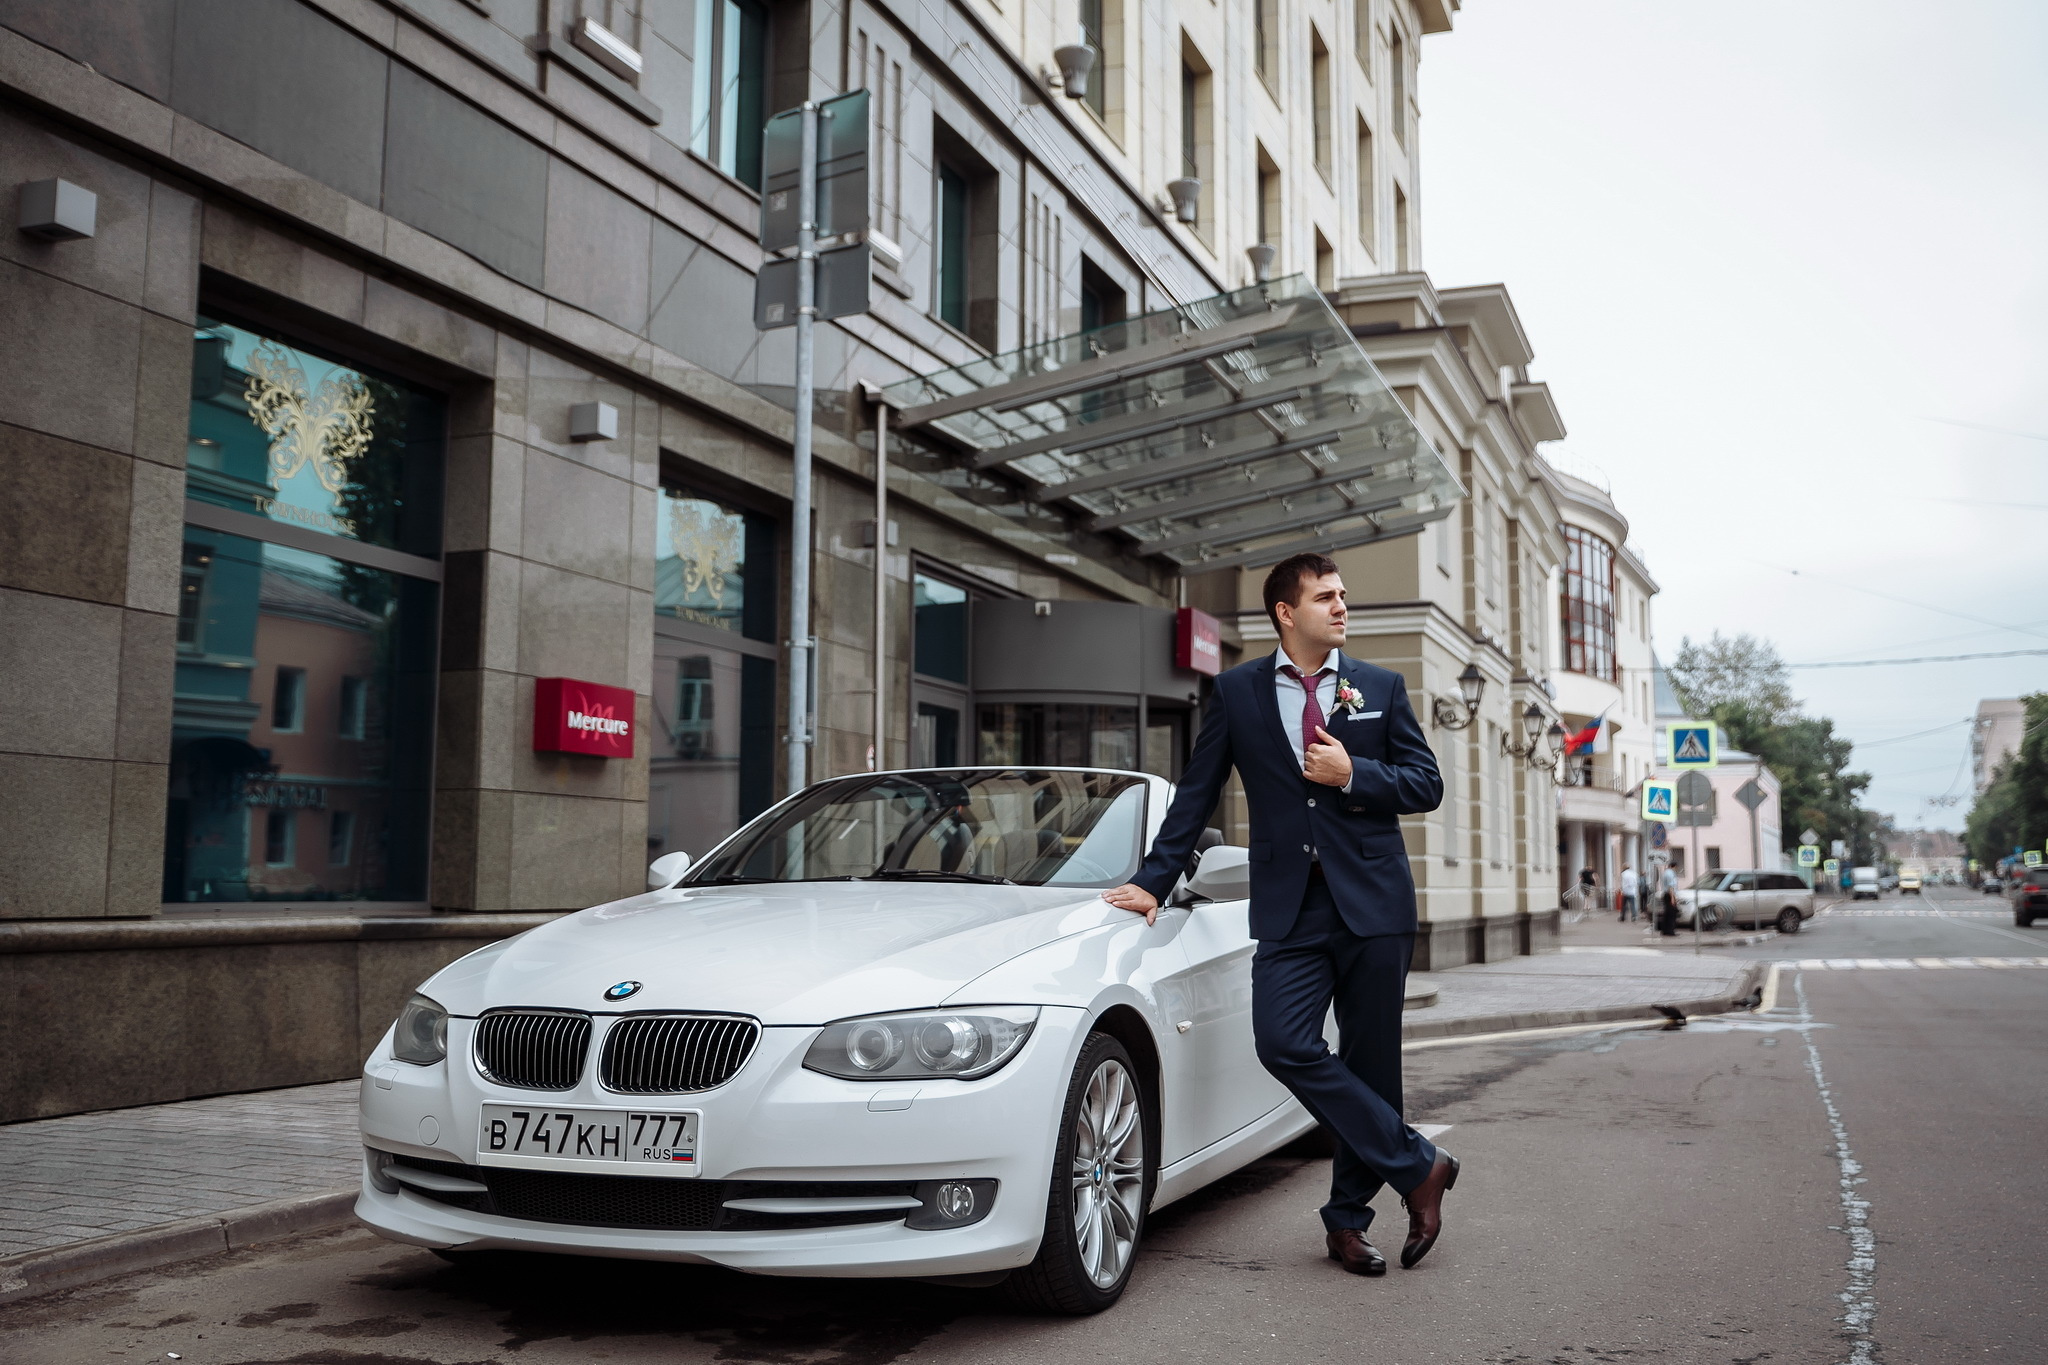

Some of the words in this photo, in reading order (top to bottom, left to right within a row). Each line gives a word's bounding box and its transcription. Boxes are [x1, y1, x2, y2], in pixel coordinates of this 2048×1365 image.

[252, 494, 356, 532] TOWNHOUSE
[567, 710, 629, 736] Mercure
[630, 1114, 687, 1147] 777
[643, 1147, 671, 1161] RUS
